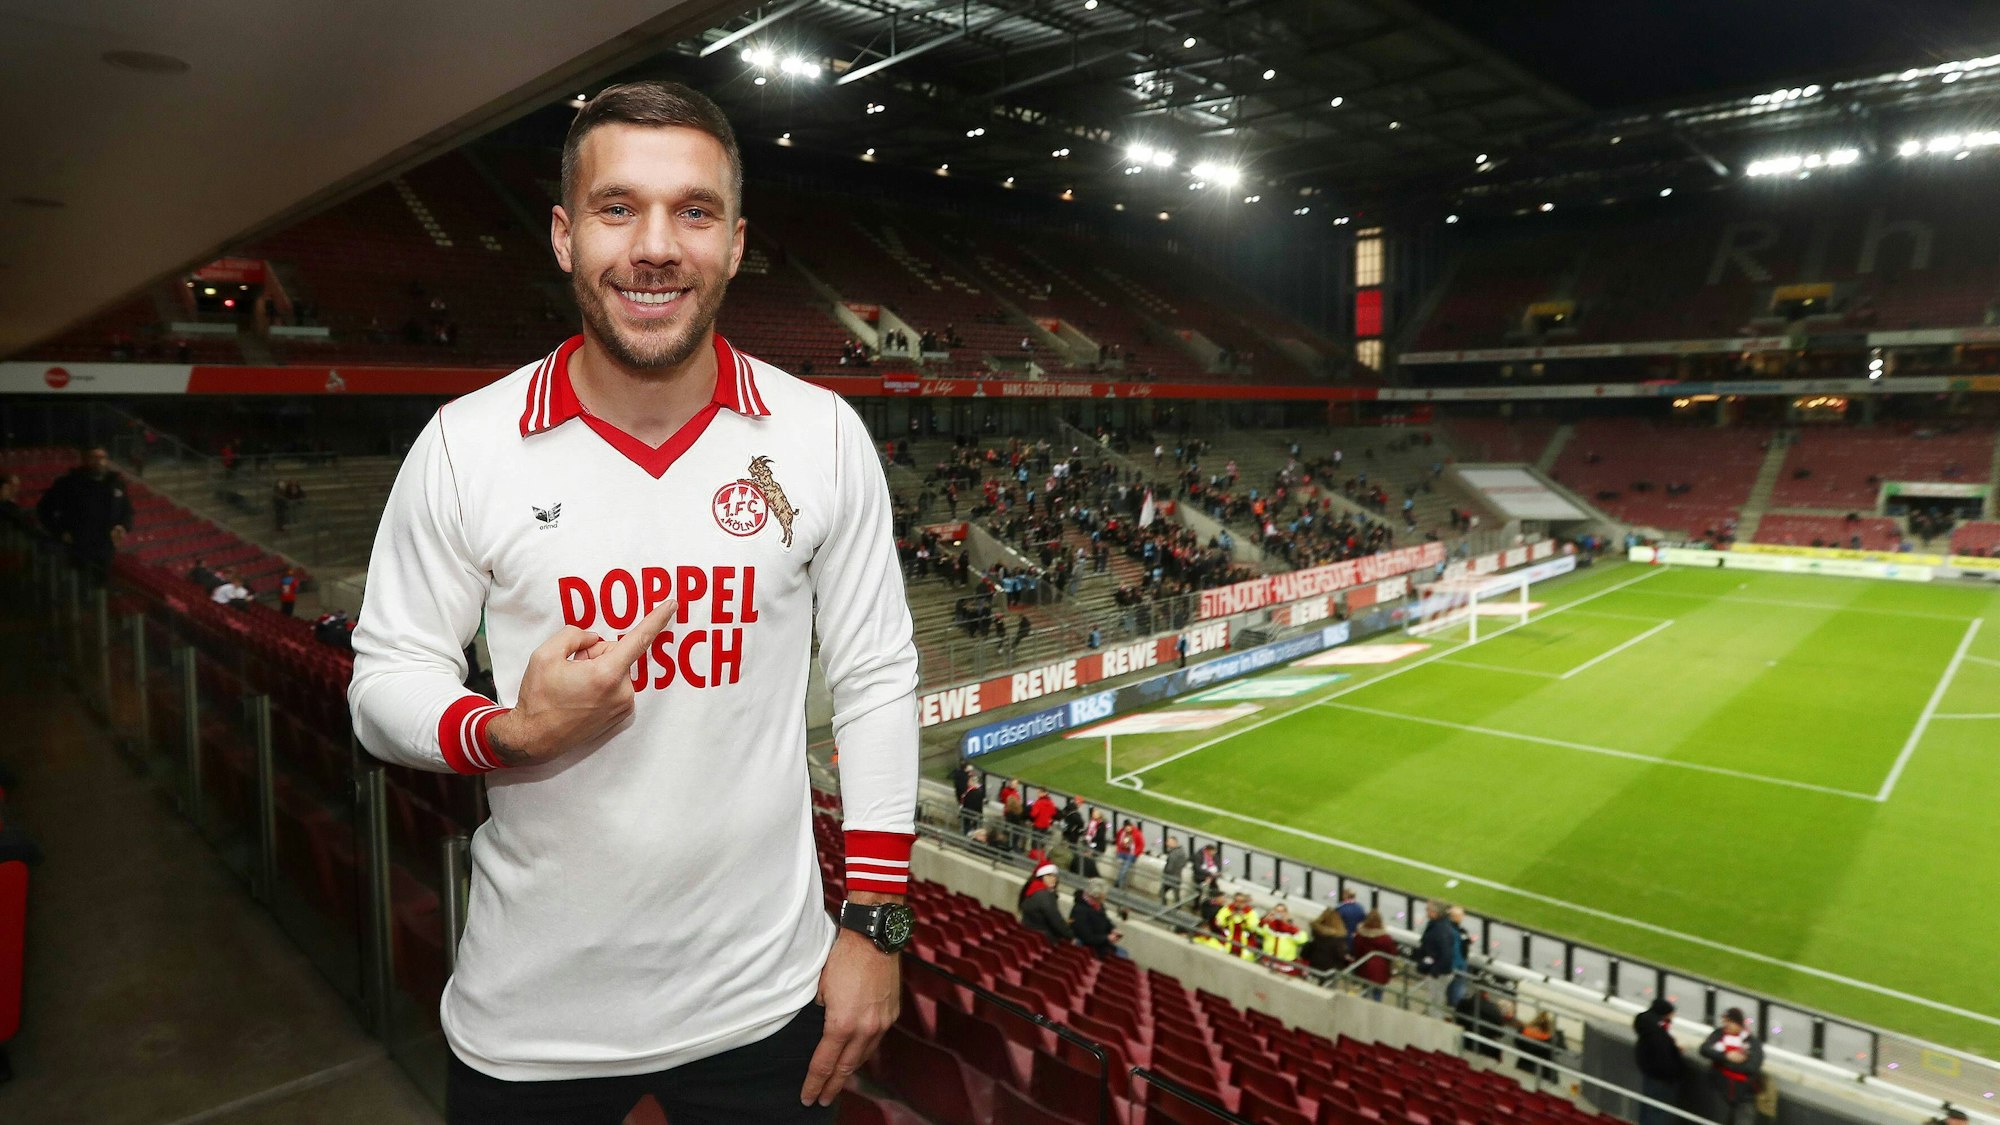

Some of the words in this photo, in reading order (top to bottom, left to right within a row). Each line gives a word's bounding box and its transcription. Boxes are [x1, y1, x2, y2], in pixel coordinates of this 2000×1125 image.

[1003, 382, 1022, 396] HANS
[725, 517, 755, 532] KÖLN
[558, 566, 758, 630] DOPPEL
[1102, 640, 1158, 679] REWE
[1011, 659, 1077, 703] REWE
[983, 710, 1065, 753] präsentiert
[1072, 692, 1115, 725] R&S
